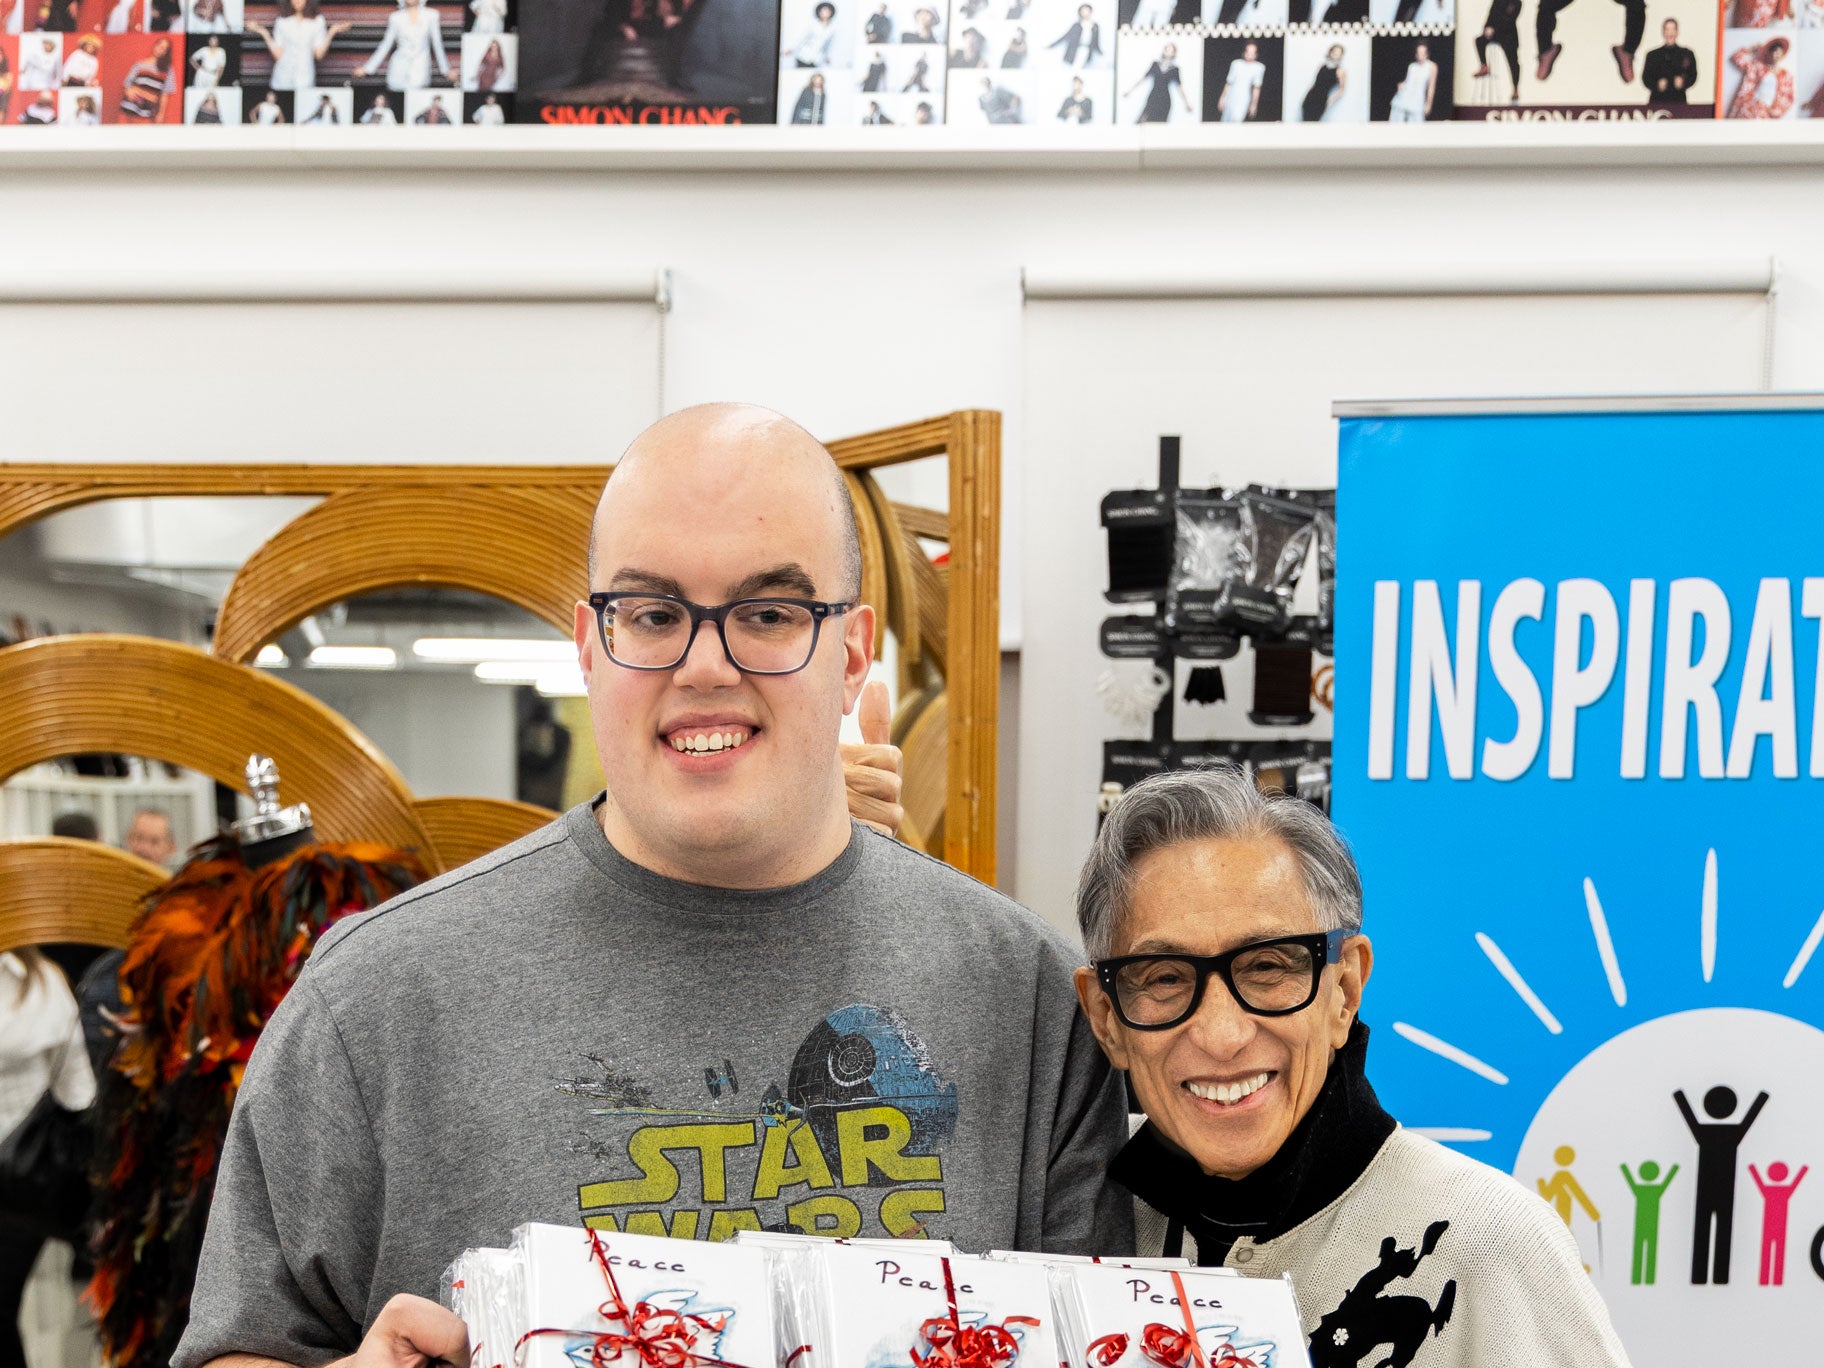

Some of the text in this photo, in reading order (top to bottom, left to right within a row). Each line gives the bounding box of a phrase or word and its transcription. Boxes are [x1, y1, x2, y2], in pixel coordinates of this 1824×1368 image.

[577, 1103, 944, 1211] STAR
[580, 1187, 947, 1241] RS
[875, 1260, 975, 1294] Peae
